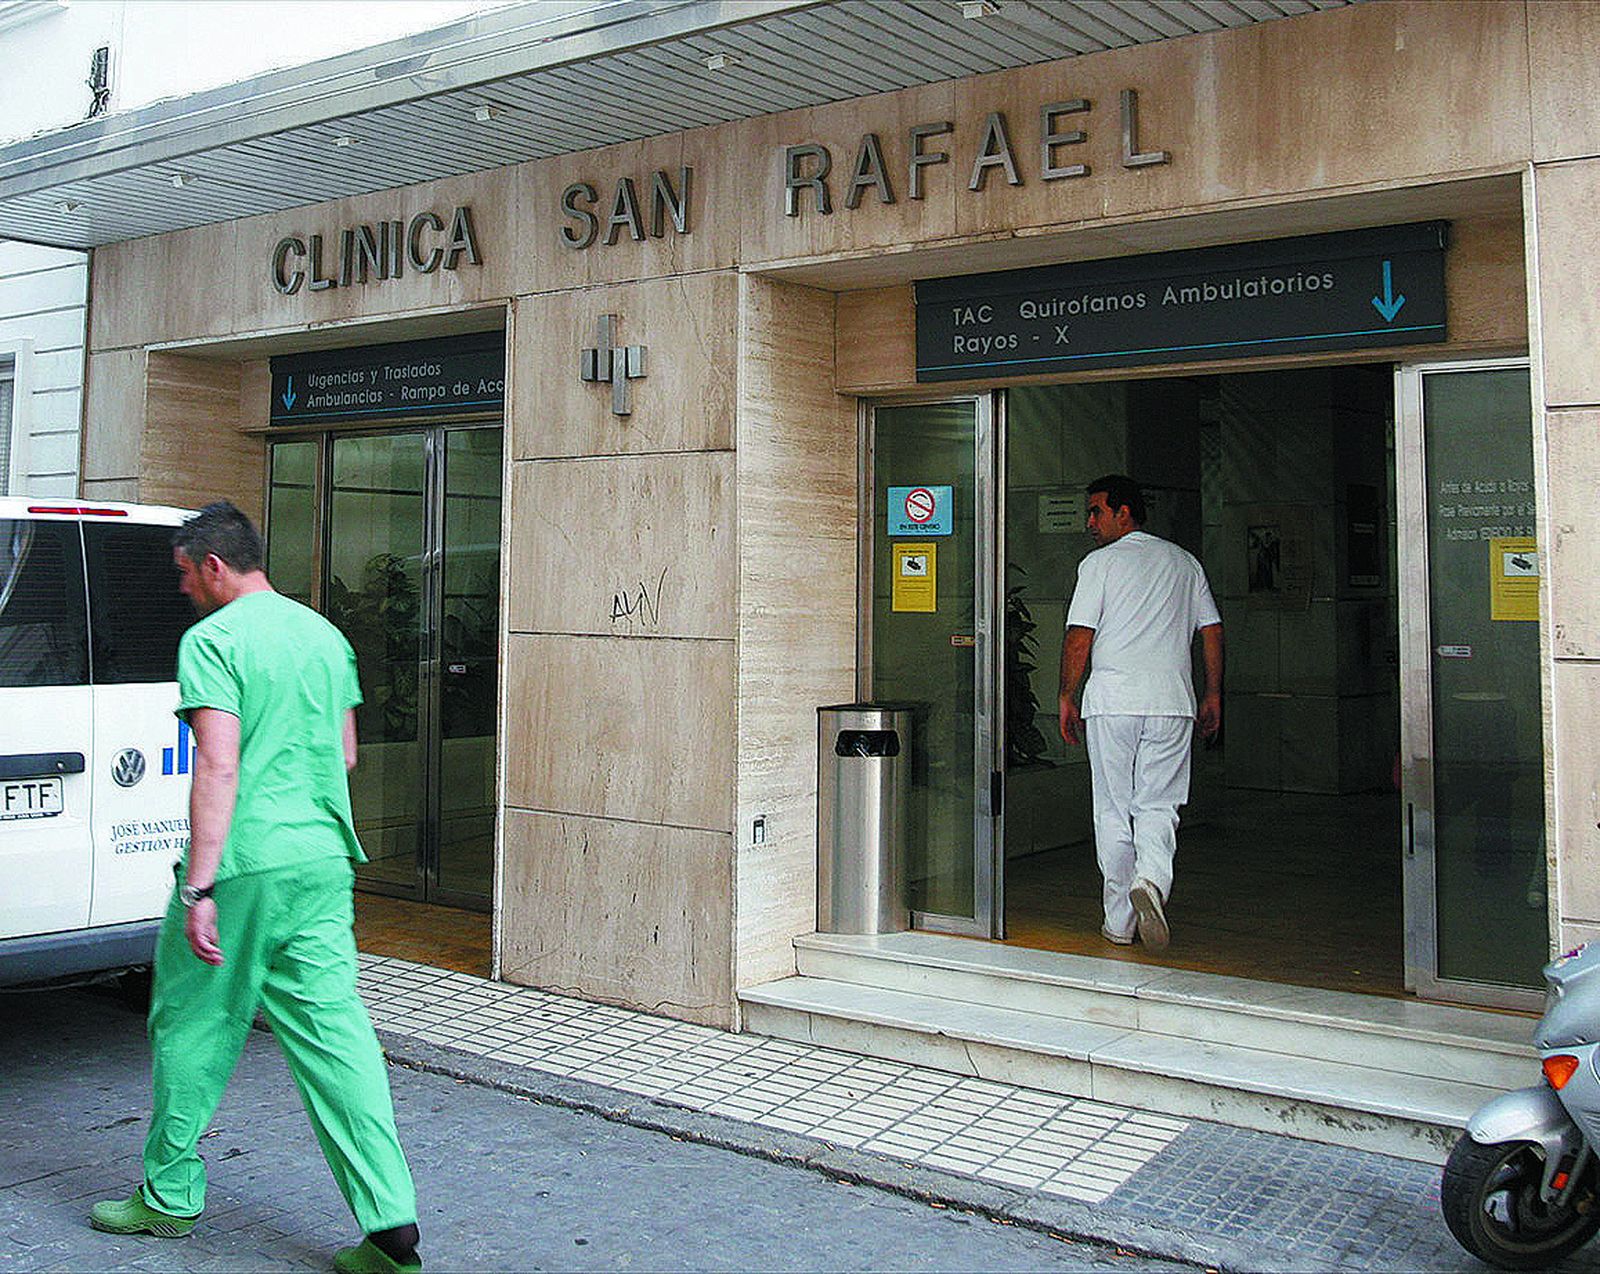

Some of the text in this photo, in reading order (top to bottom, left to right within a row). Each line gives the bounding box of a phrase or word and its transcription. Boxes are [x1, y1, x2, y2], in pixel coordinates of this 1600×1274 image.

[271, 88, 1173, 295] CLINICA SAN RAFAEL
[952, 271, 1335, 327] TAC Quirofanos Ambulatorios
[953, 331, 1018, 355] Rayos
[1054, 325, 1070, 345] X
[308, 362, 442, 390] Urgencias y Traslados
[306, 388, 383, 408] Ambulancias
[401, 384, 447, 400] Rampa
[452, 381, 470, 396] de
[5, 783, 53, 810] FTF
[141, 818, 192, 835] MANUEL
